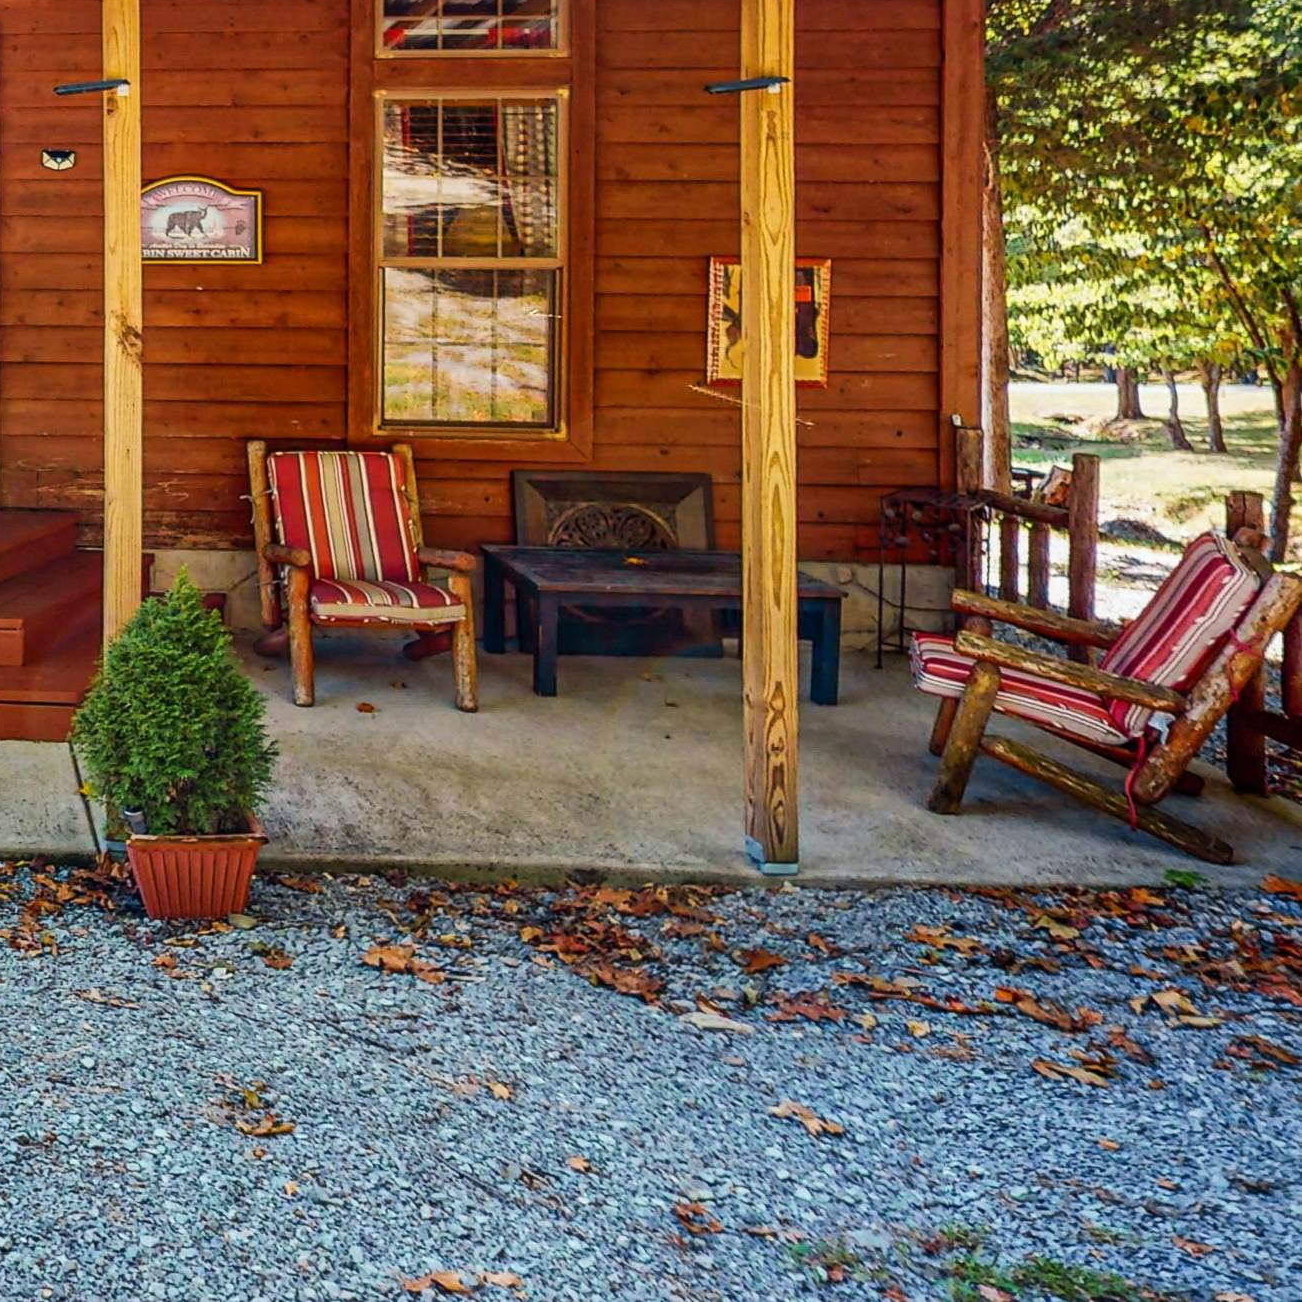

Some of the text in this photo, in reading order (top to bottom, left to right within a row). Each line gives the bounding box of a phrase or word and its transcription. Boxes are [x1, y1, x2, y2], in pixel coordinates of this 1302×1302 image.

[154, 185, 223, 199] WELCOME
[142, 249, 165, 258] BIN
[167, 249, 208, 258] SWEET
[210, 246, 251, 258] CABIN
